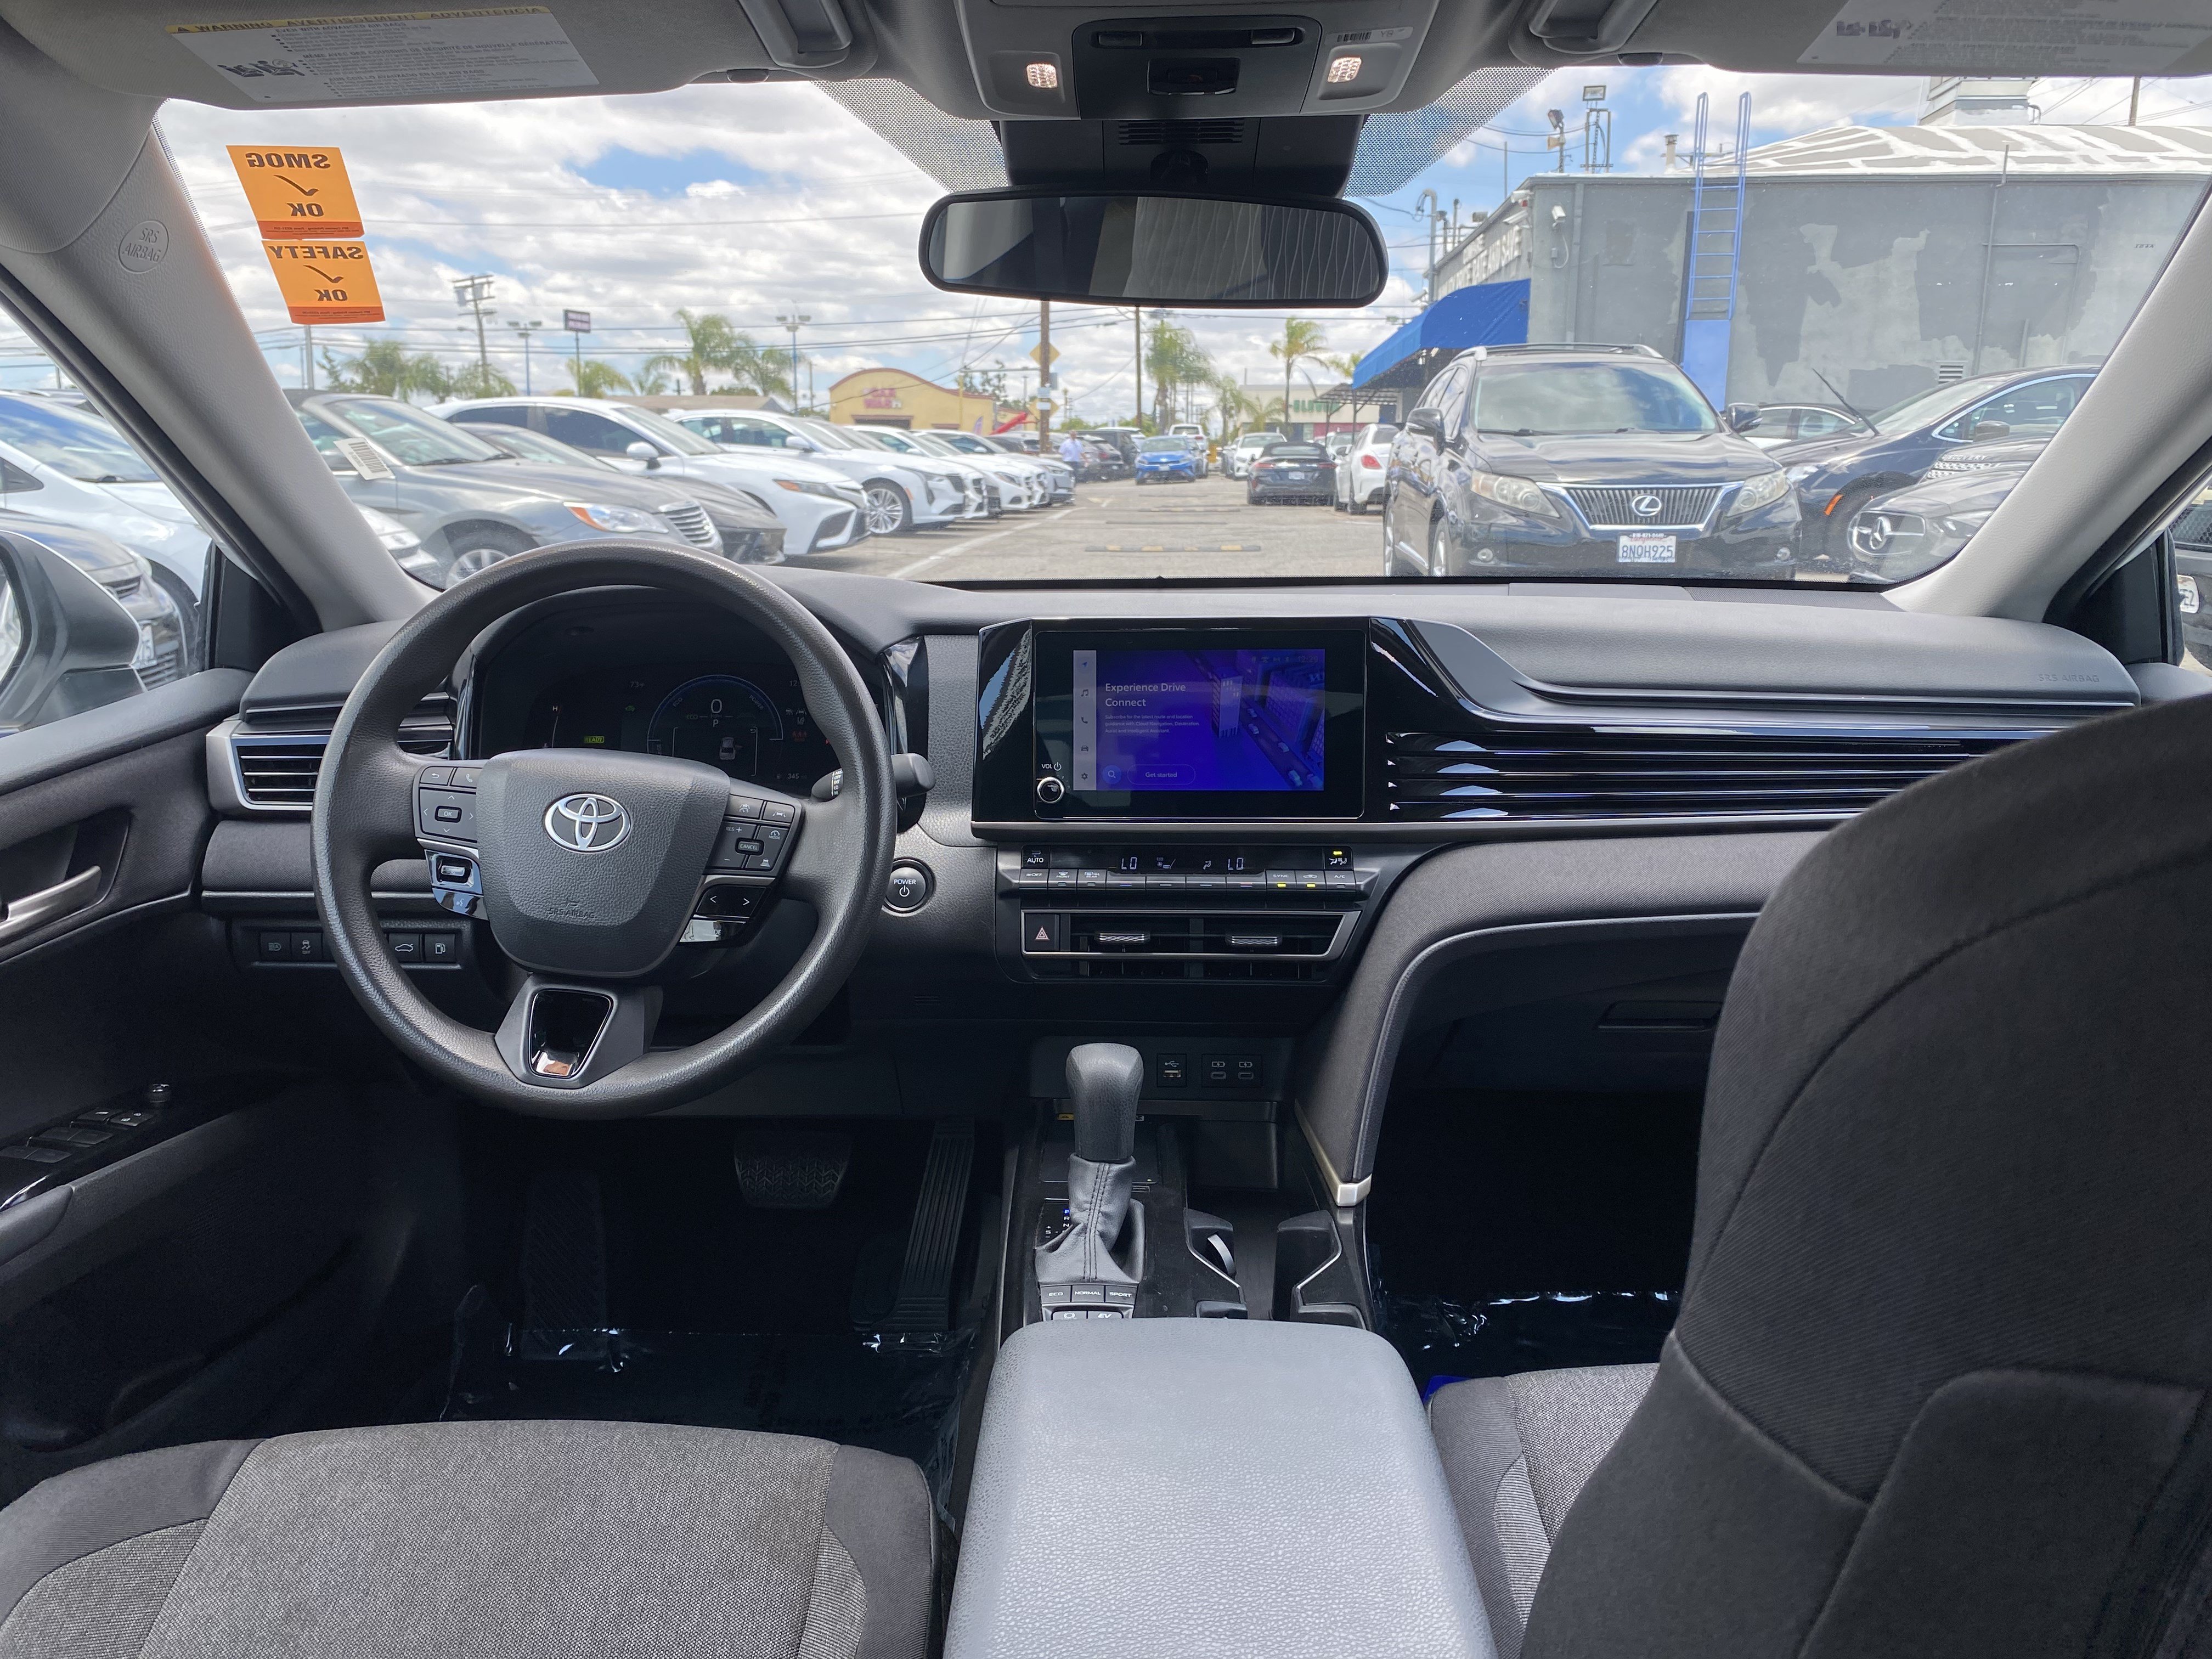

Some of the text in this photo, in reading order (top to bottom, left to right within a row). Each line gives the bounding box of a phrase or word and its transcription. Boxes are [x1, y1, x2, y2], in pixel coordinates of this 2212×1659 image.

[195, 21, 273, 32] WARNING
[139, 228, 160, 244] SRS
[122, 243, 161, 263] AIRBAG
[2038, 674, 2100, 683] SRS AIRBAG
[1105, 683, 1186, 693] Experience Drive
[710, 699, 723, 714] 0
[1105, 698, 1146, 707] Connect
[713, 719, 719, 727] P
